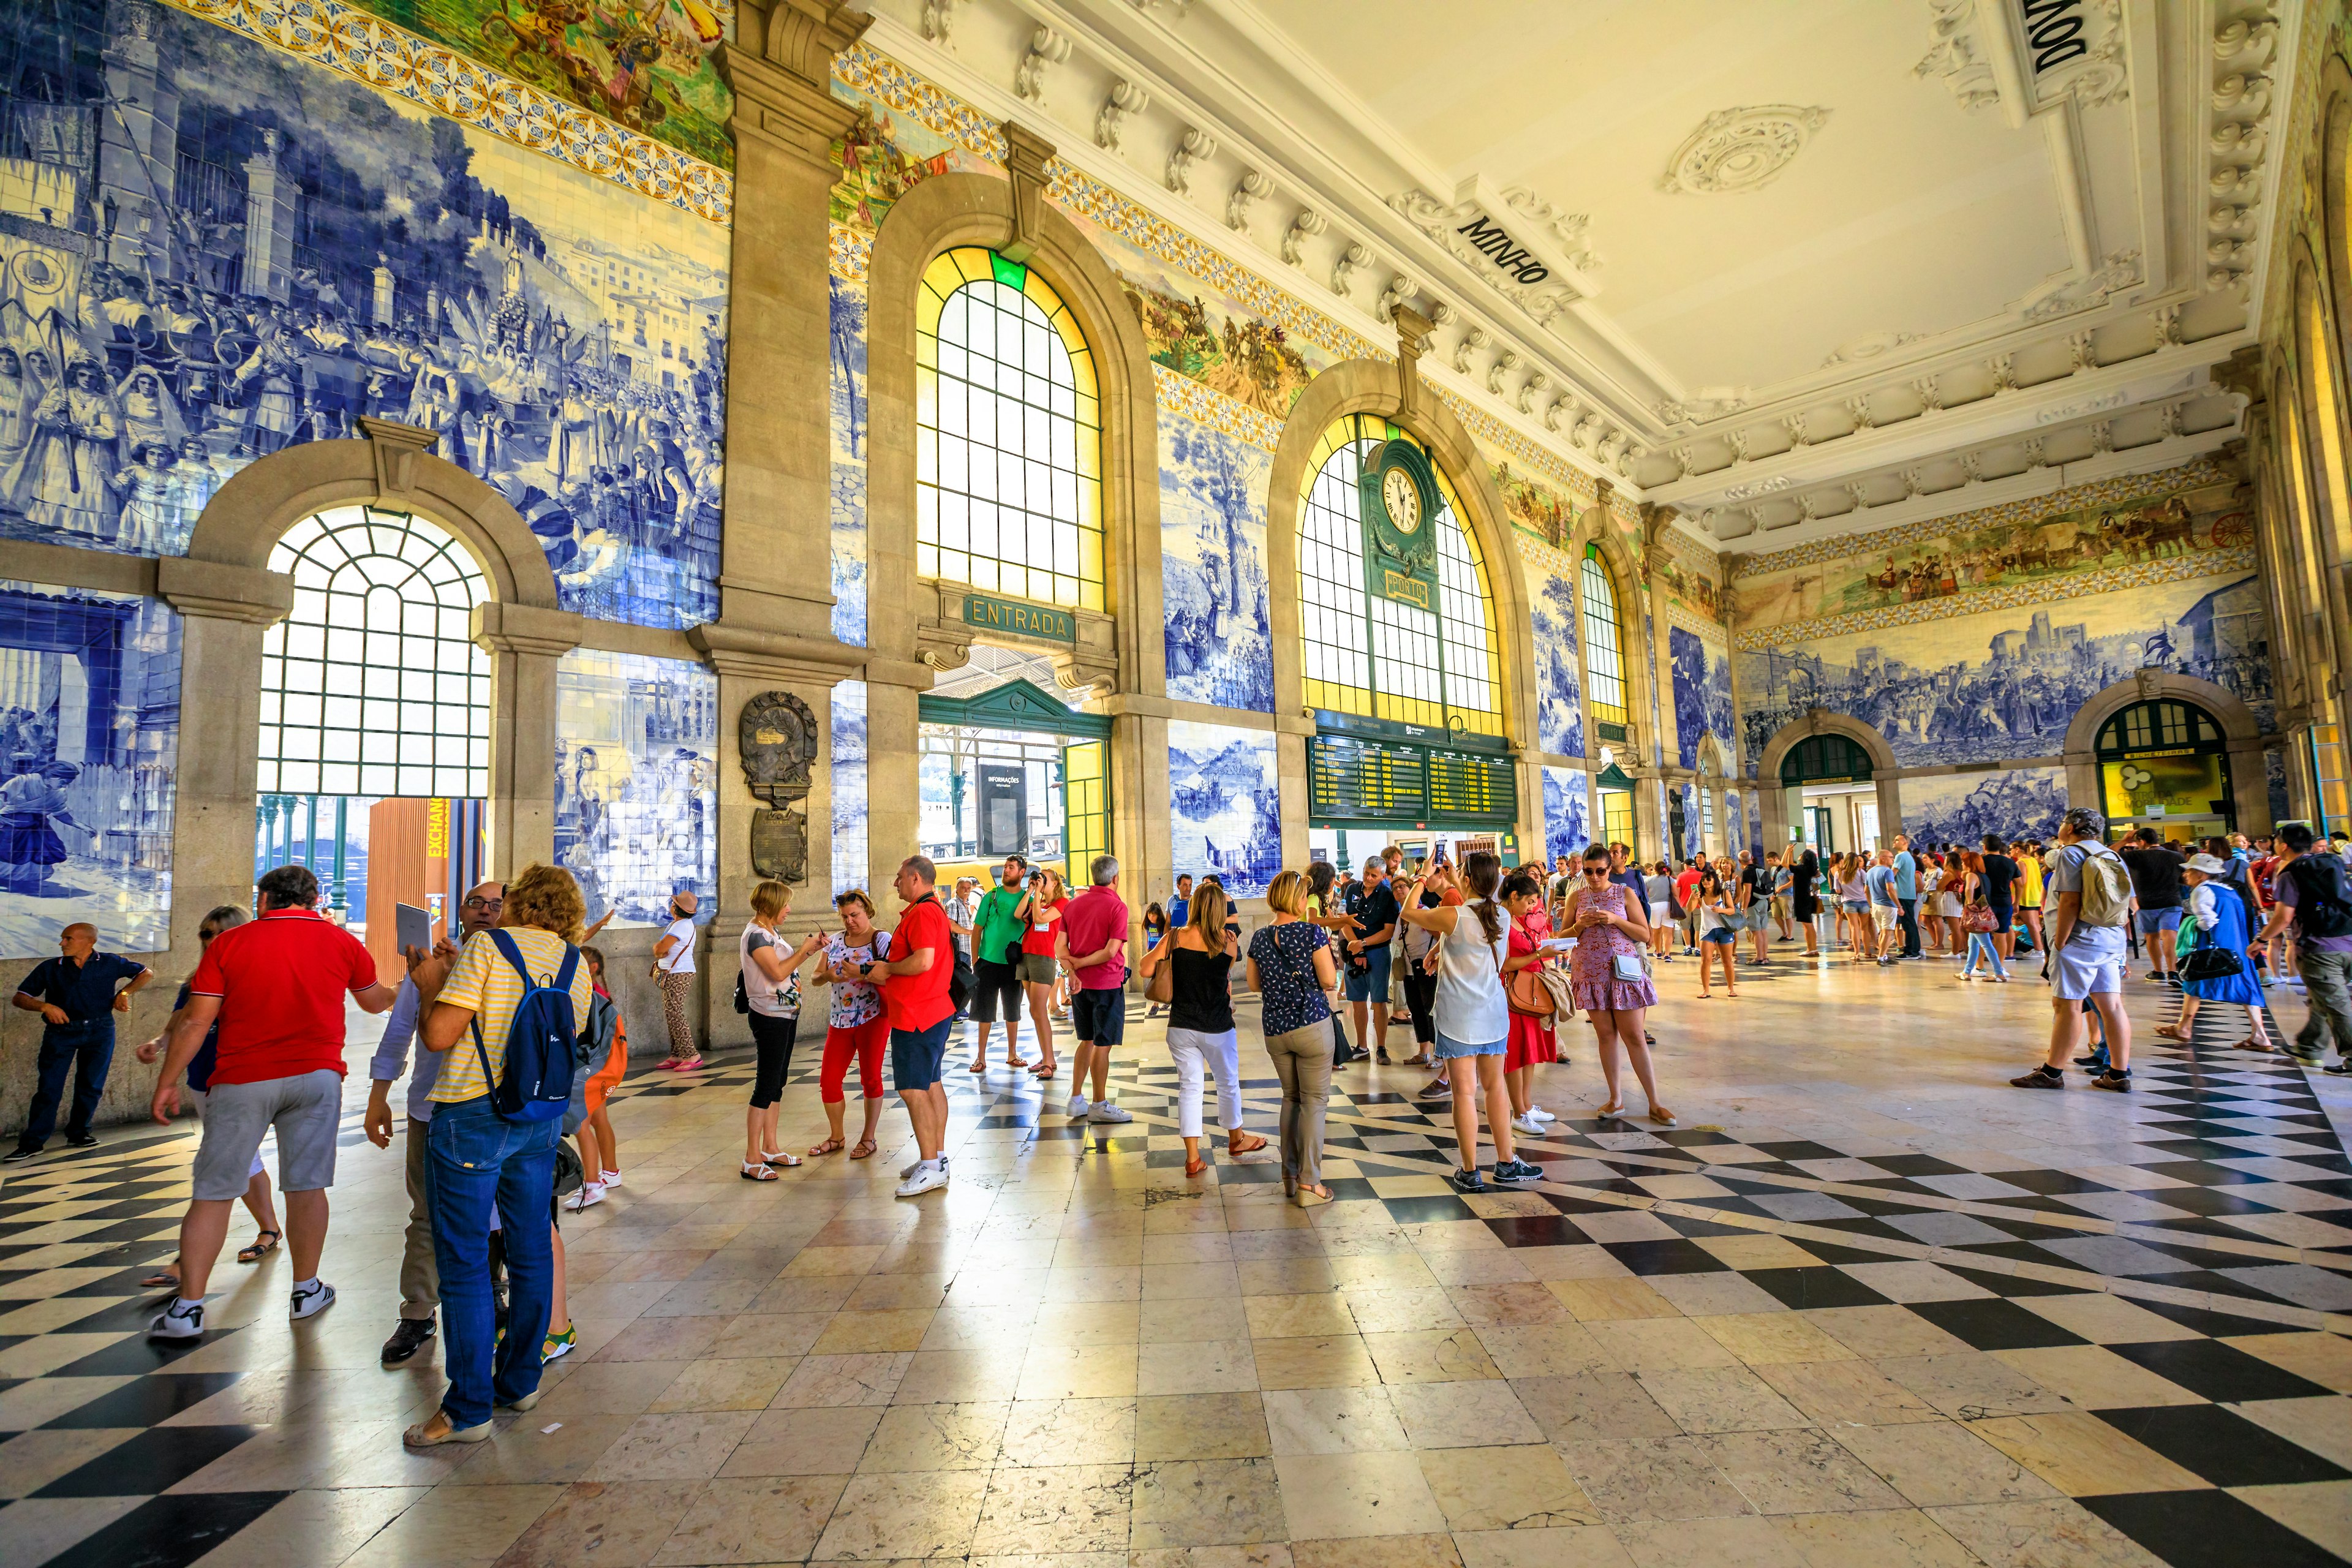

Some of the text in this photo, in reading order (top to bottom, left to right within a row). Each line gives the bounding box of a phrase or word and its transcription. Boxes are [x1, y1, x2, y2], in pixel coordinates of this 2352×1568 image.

[1457, 215, 1548, 284] MINHO
[1392, 576, 1421, 598] PORTO
[973, 600, 1066, 637] ENTRADA
[2130, 749, 2190, 758] BILHETEIRAS
[2117, 790, 2173, 801] CENTRO DA
